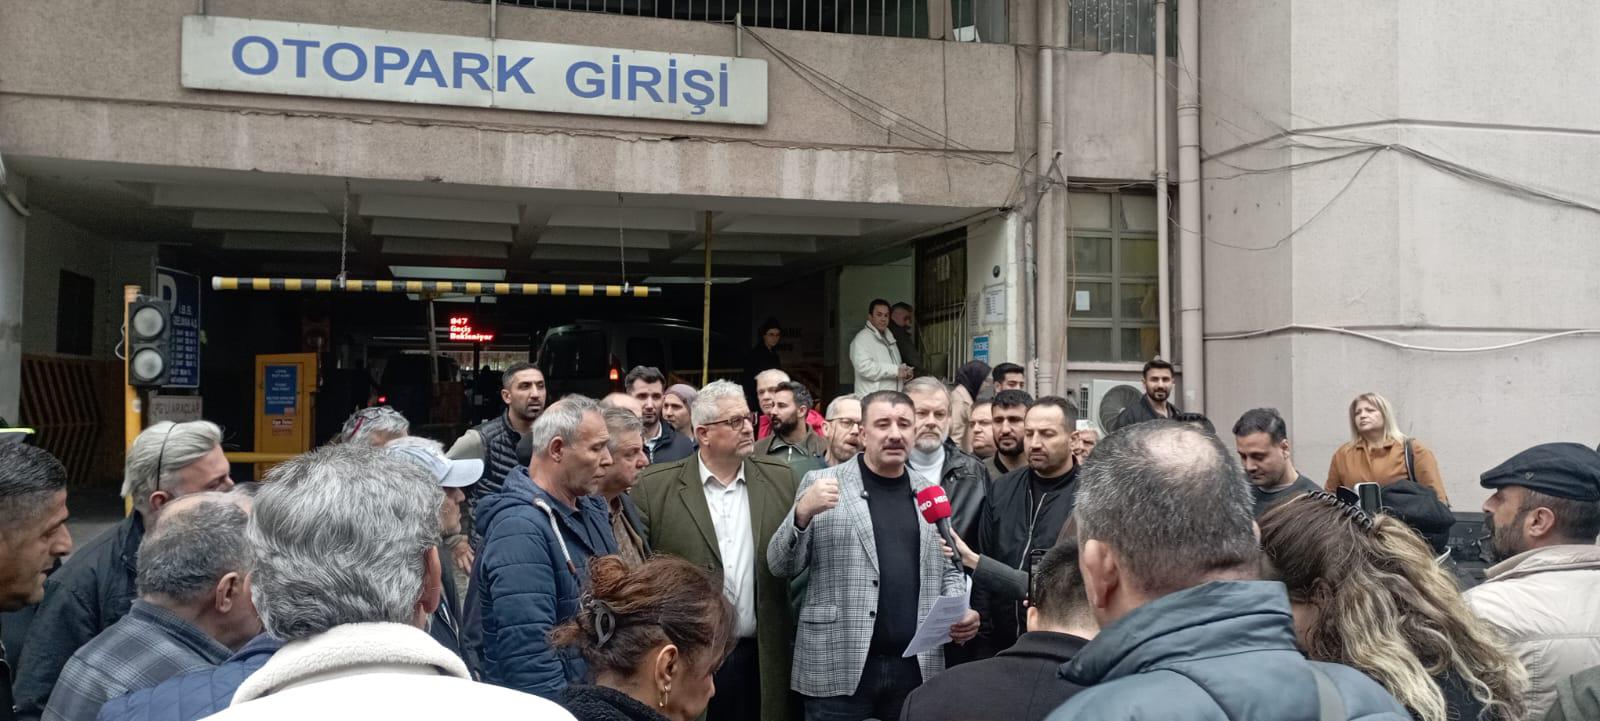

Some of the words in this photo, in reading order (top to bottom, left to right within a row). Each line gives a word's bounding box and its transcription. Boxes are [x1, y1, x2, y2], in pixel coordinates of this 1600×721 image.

[233, 36, 534, 93] OTOPARK
[566, 54, 728, 114] GİRİŞİ
[450, 333, 493, 341] Bekleniyor
